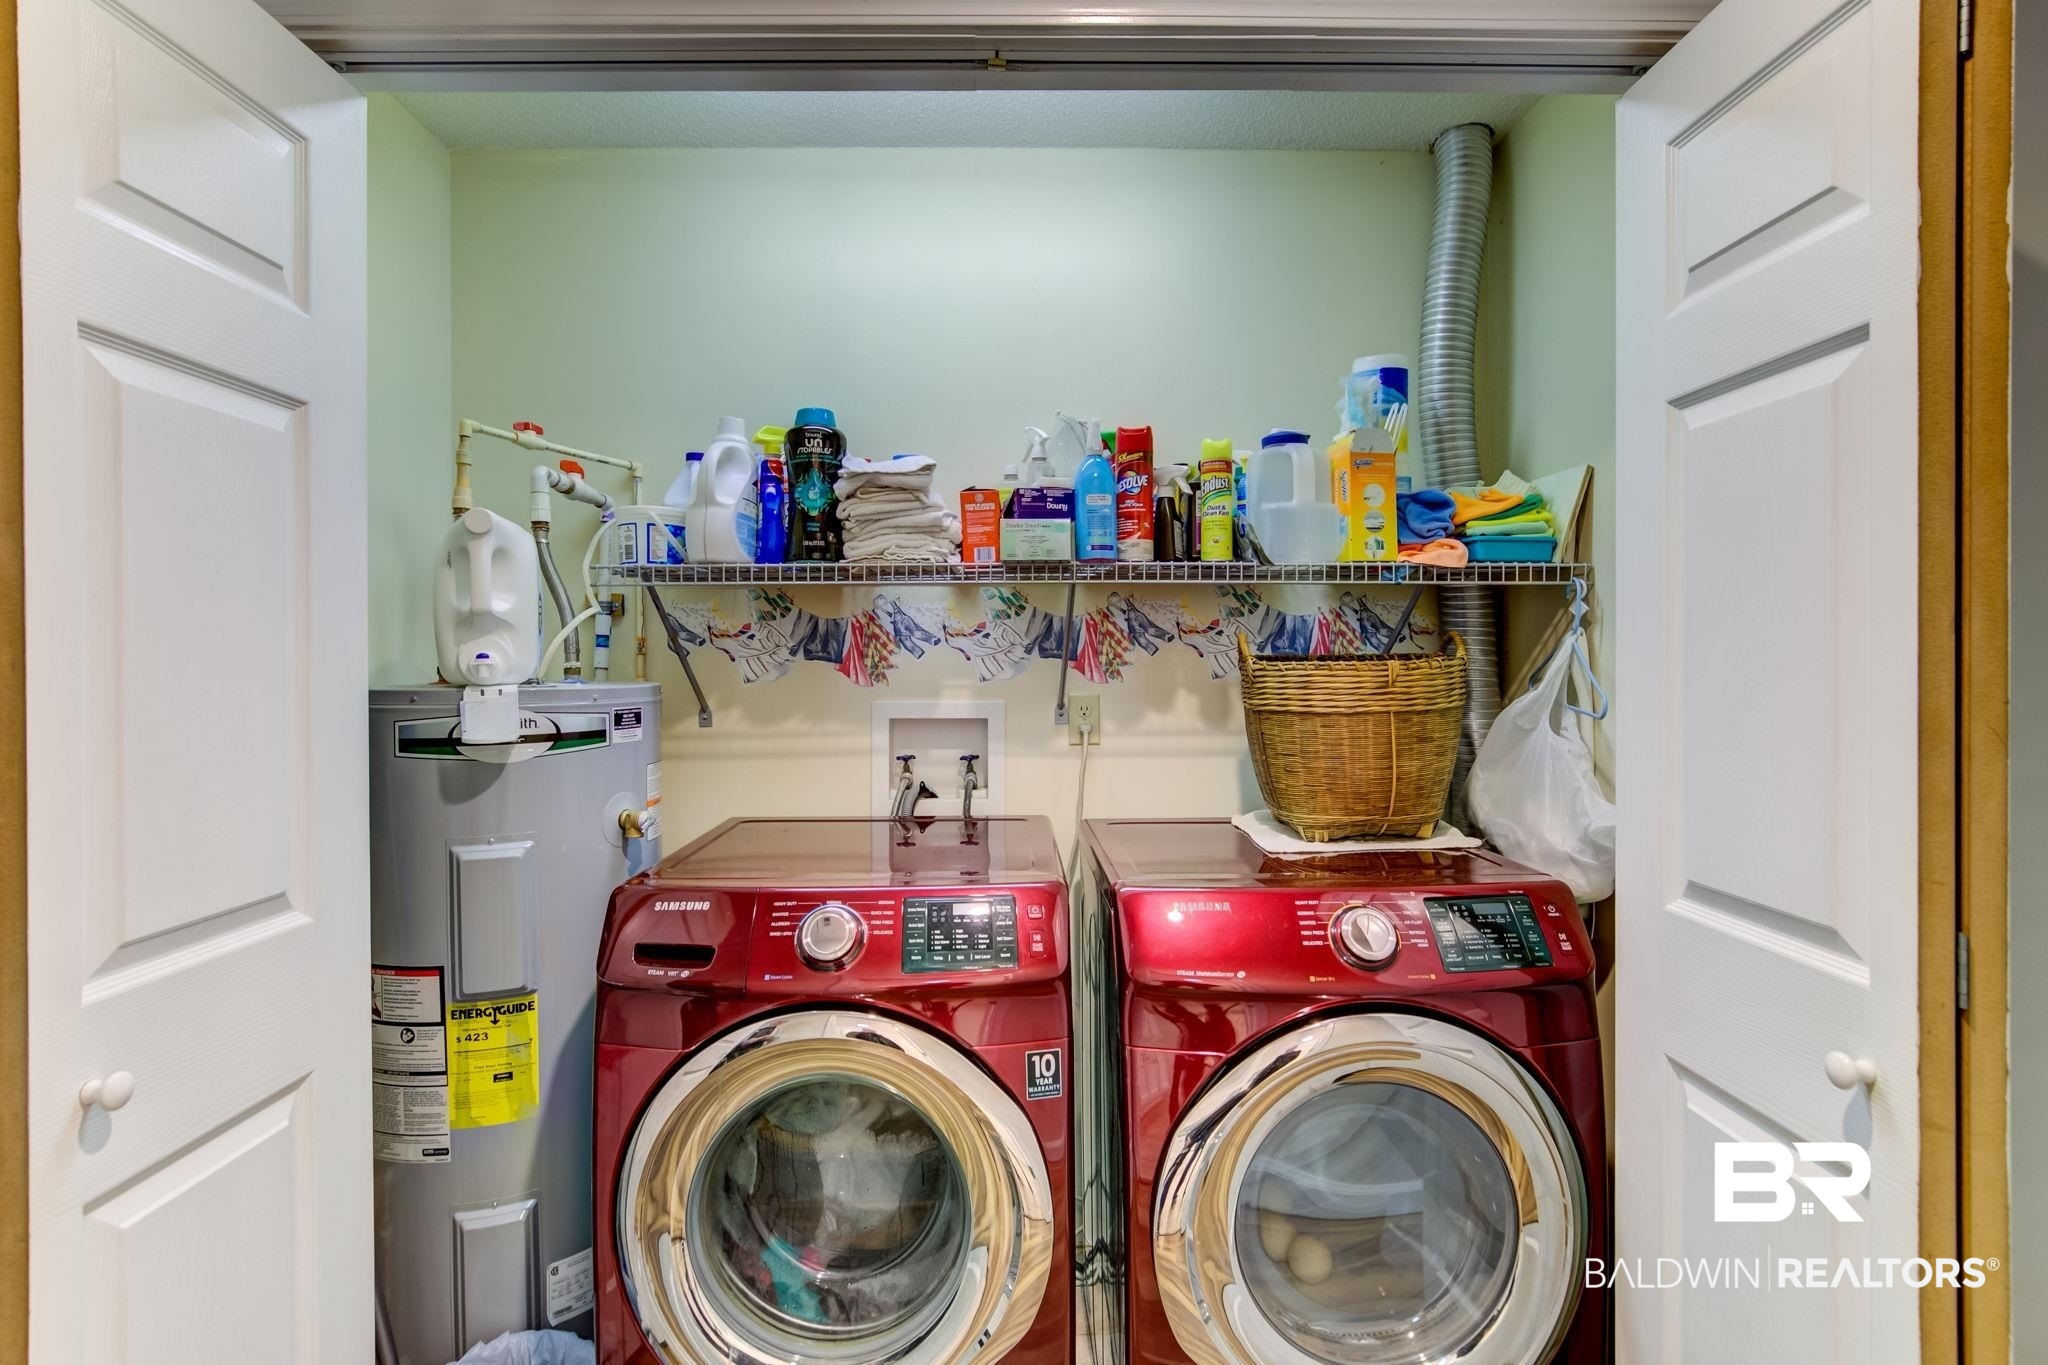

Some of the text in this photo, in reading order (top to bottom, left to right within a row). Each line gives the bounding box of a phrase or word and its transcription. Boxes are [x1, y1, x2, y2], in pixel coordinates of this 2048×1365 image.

[1046, 502, 1068, 511] Downy
[654, 901, 710, 911] SAMSUNG
[451, 1000, 535, 1022] ENERGYGUIDE
[465, 1032, 489, 1042] 423
[1032, 1054, 1056, 1078] 10
[1029, 1084, 1060, 1093] WARRANTY
